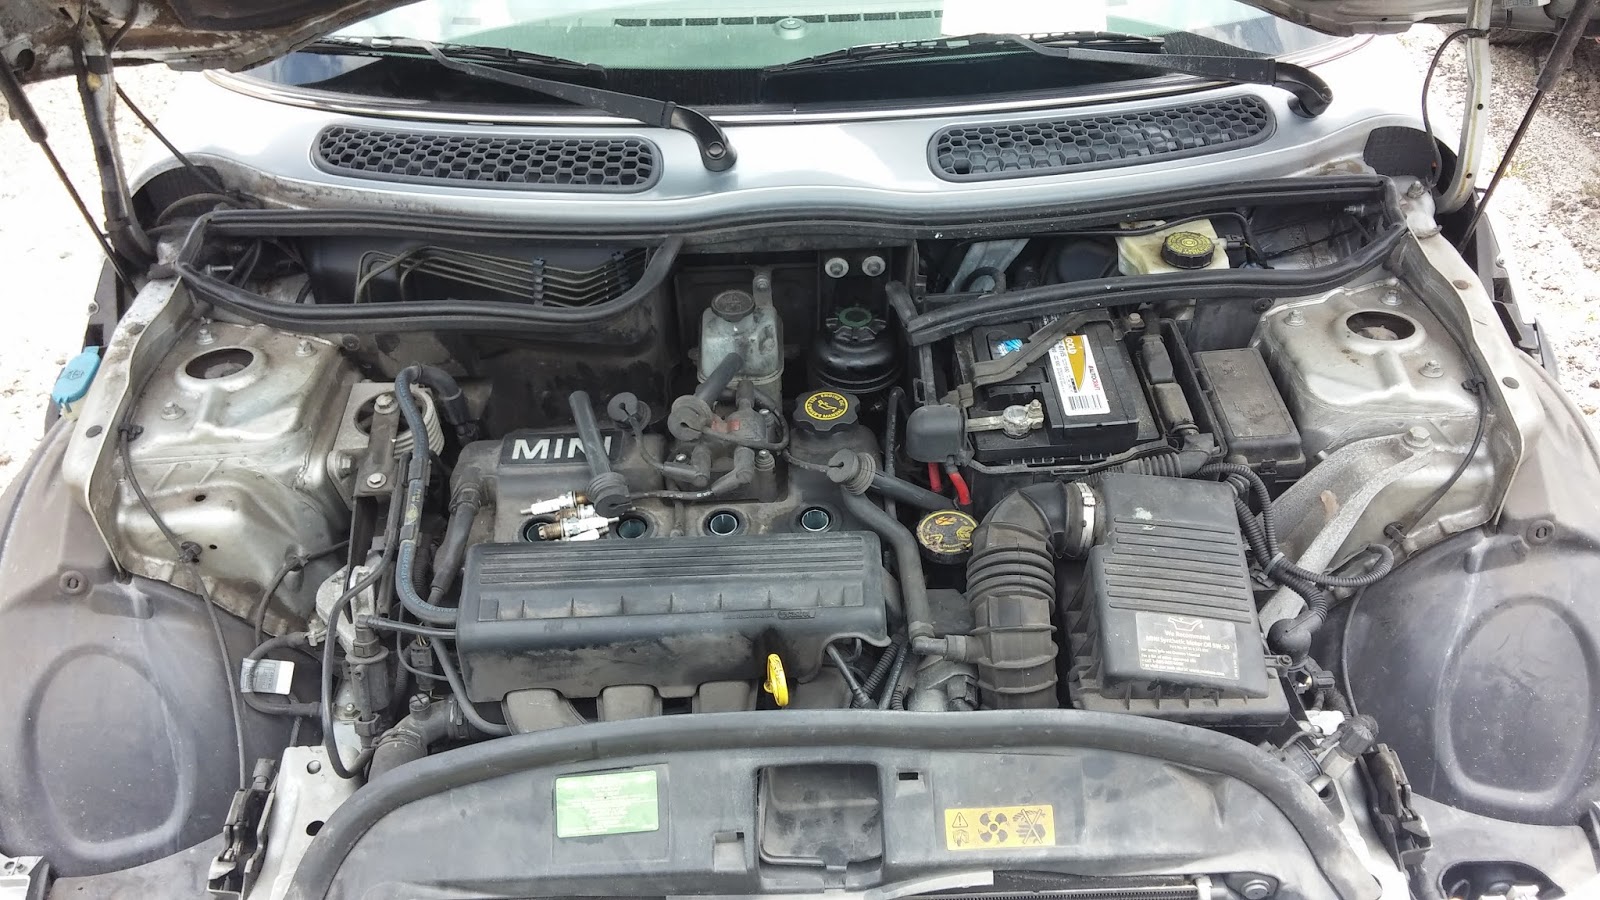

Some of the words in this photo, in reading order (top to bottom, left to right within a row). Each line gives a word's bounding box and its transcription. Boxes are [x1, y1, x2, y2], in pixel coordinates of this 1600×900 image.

[1065, 337, 1077, 355] GOLD
[1160, 636, 1185, 645] Synthetic
[1164, 629, 1174, 637] We
[1175, 631, 1211, 641] Recommend
